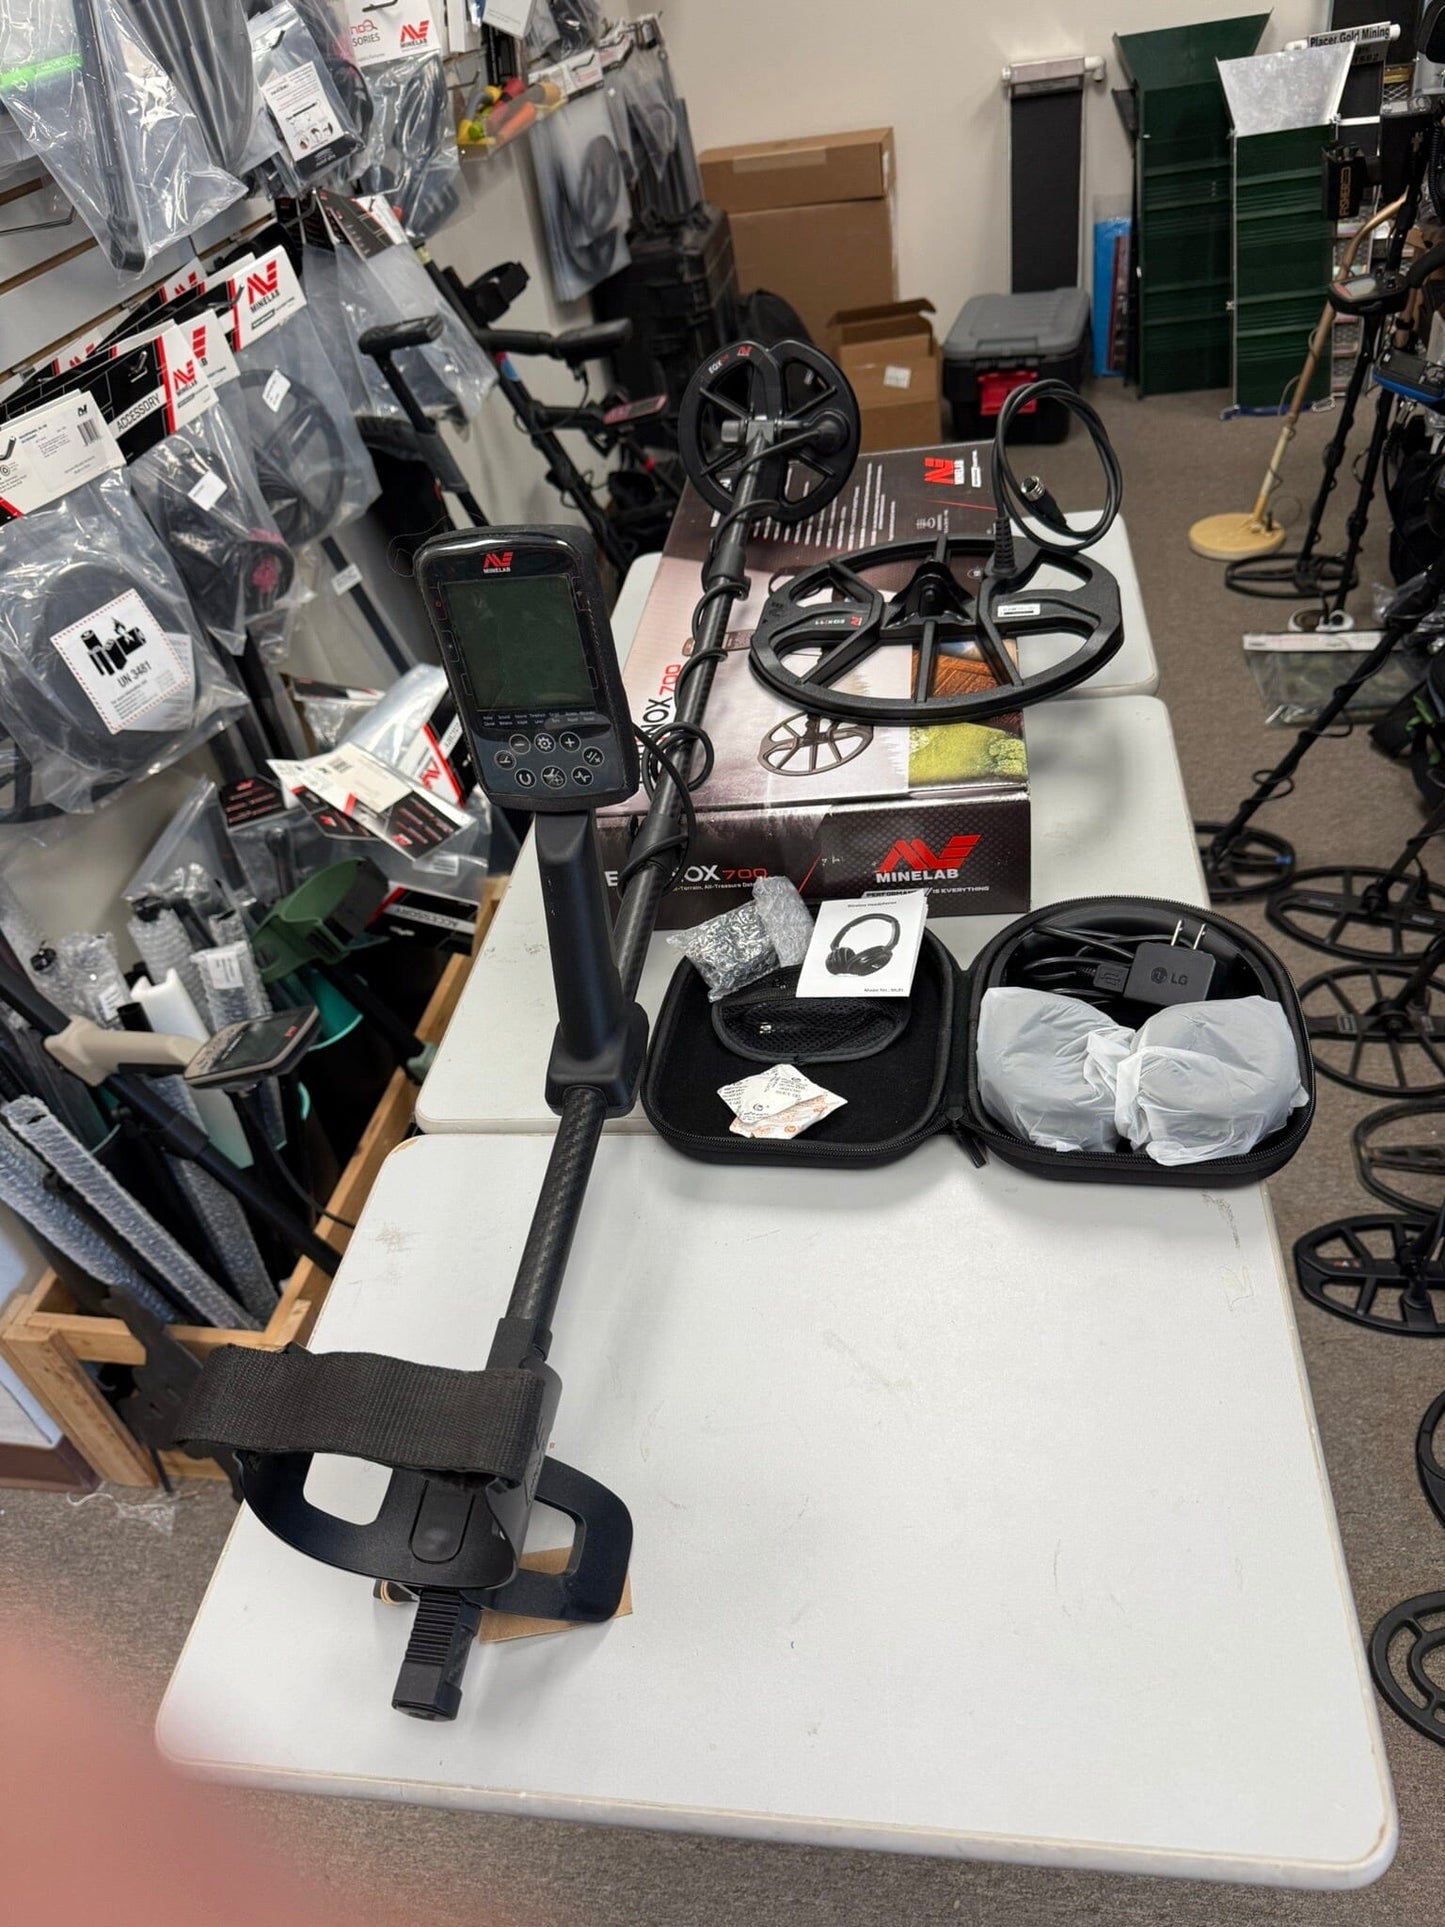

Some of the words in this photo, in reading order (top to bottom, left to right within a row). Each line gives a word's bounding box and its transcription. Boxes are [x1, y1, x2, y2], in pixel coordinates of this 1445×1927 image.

[400, 38, 427, 48] MINELAB
[1310, 35, 1337, 47] Placer
[1362, 26, 1391, 39] Mining
[250, 289, 280, 313] MINELAB
[117, 393, 161, 432] ACCESSORY
[482, 566, 512, 574] MINELAB
[117, 672, 132, 688] UN
[130, 660, 152, 680] 3481
[659, 663, 682, 696] 700
[722, 868, 768, 880] 700
[876, 868, 960, 884] MINELAB
[941, 886, 990, 894] EVERYTHING
[1171, 973, 1189, 986] LG
